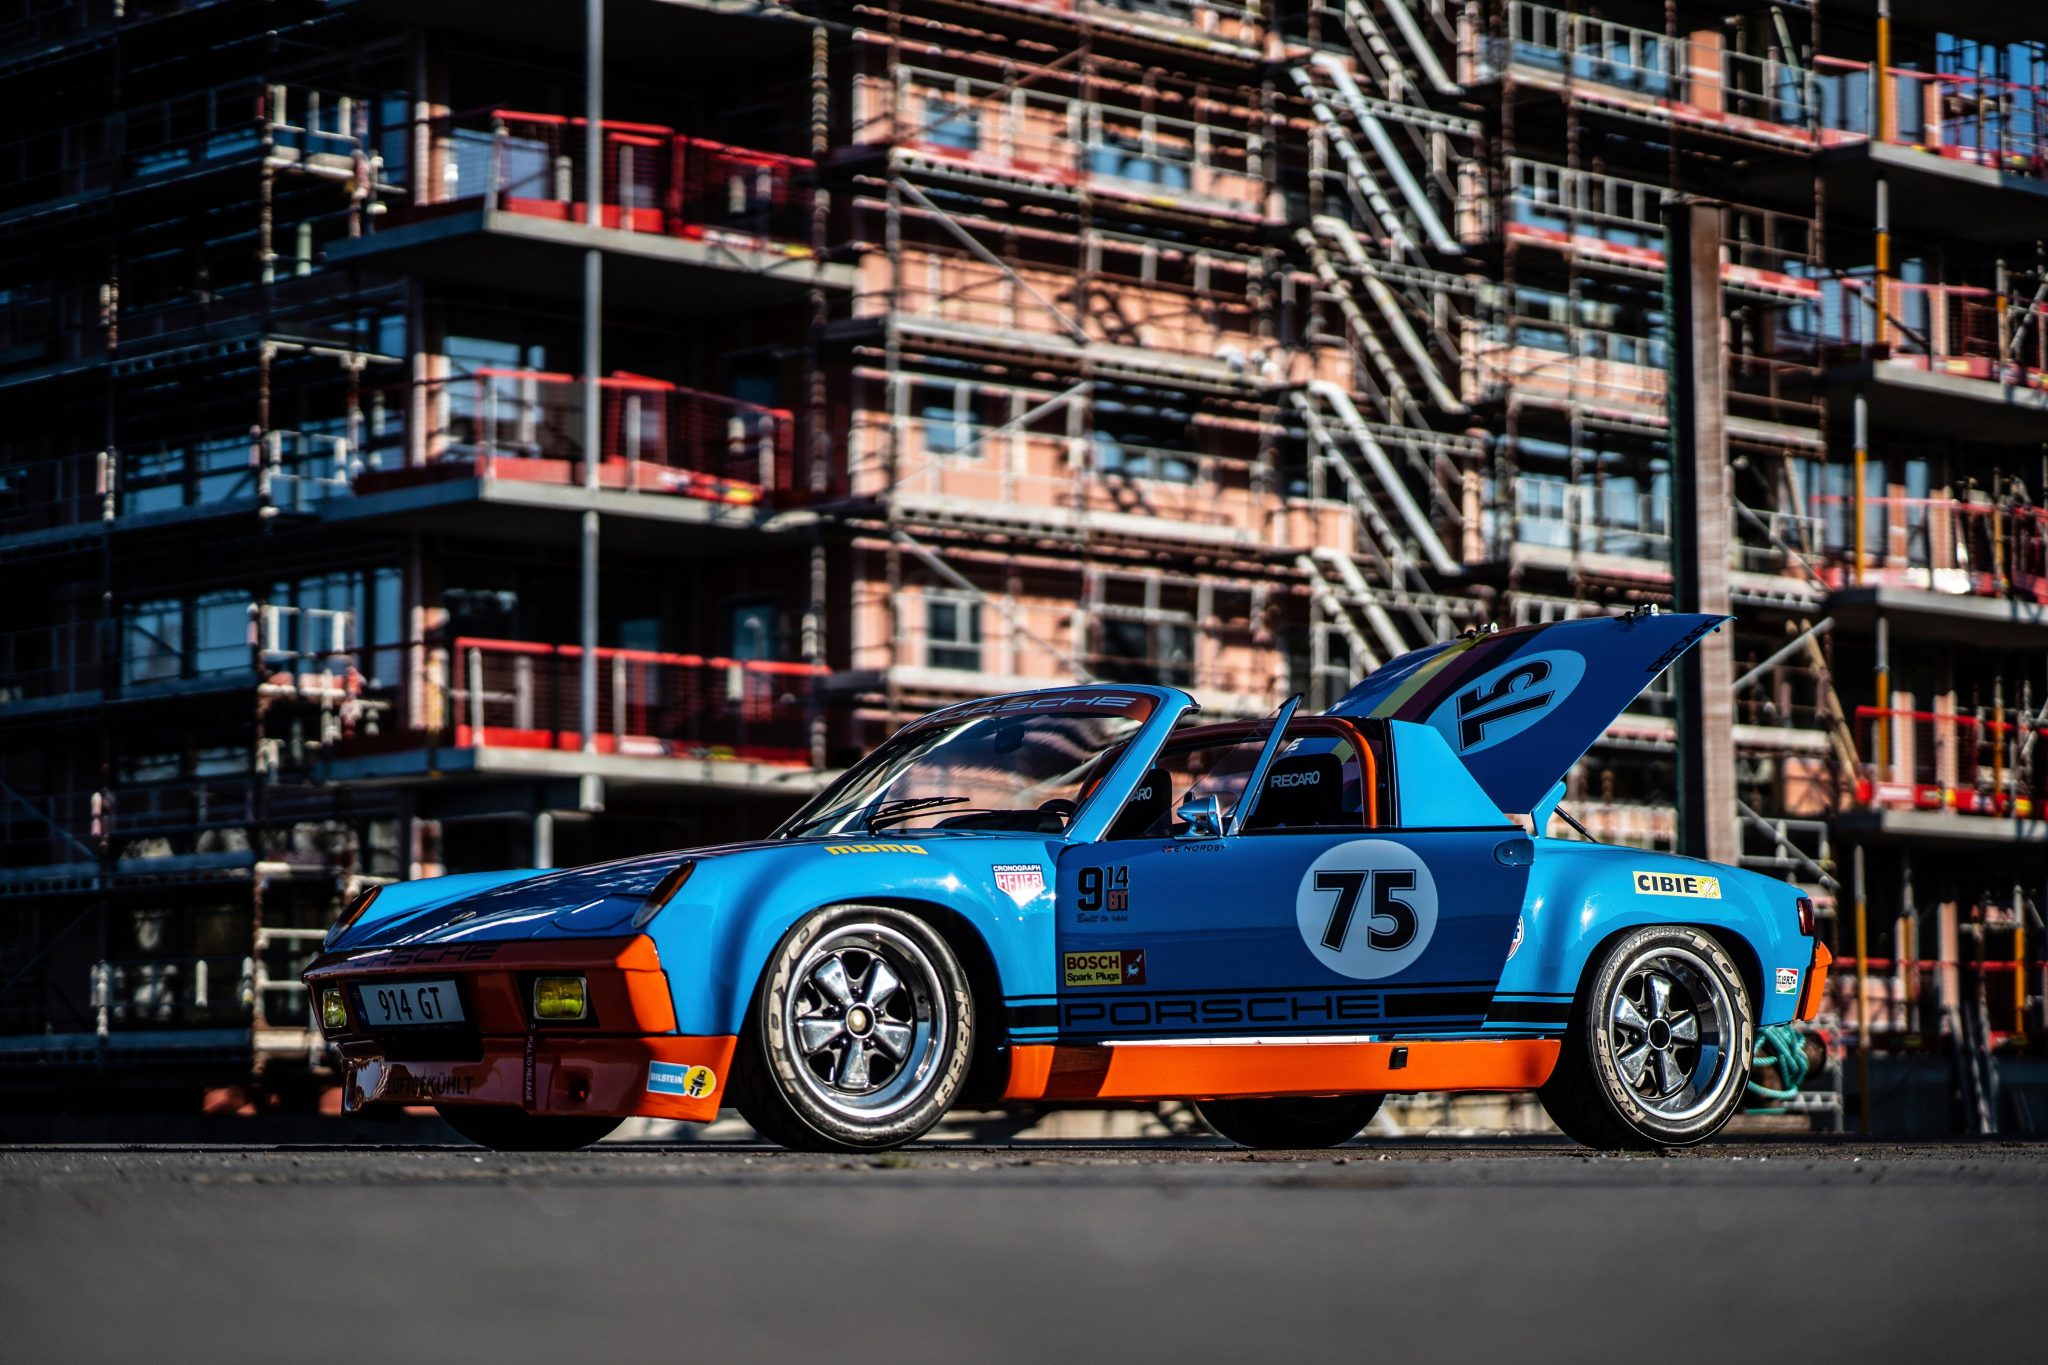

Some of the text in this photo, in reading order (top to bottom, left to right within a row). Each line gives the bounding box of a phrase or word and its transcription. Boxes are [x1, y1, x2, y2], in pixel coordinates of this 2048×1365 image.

[1456, 659, 1556, 752] 75
[1270, 770, 1320, 788] RECARO
[1313, 869, 1418, 952] 75
[1066, 956, 1119, 969] BOSCH
[1067, 971, 1119, 983] Spark Plugs
[378, 986, 443, 1021] 914 GT
[769, 914, 823, 1093] TOYO
[1064, 994, 1380, 1027] PORSCHE
[1685, 930, 1751, 1072] TOYO
[525, 1035, 534, 1101] PULL TO RELEASE
[650, 1072, 683, 1084] BILSTEIN
